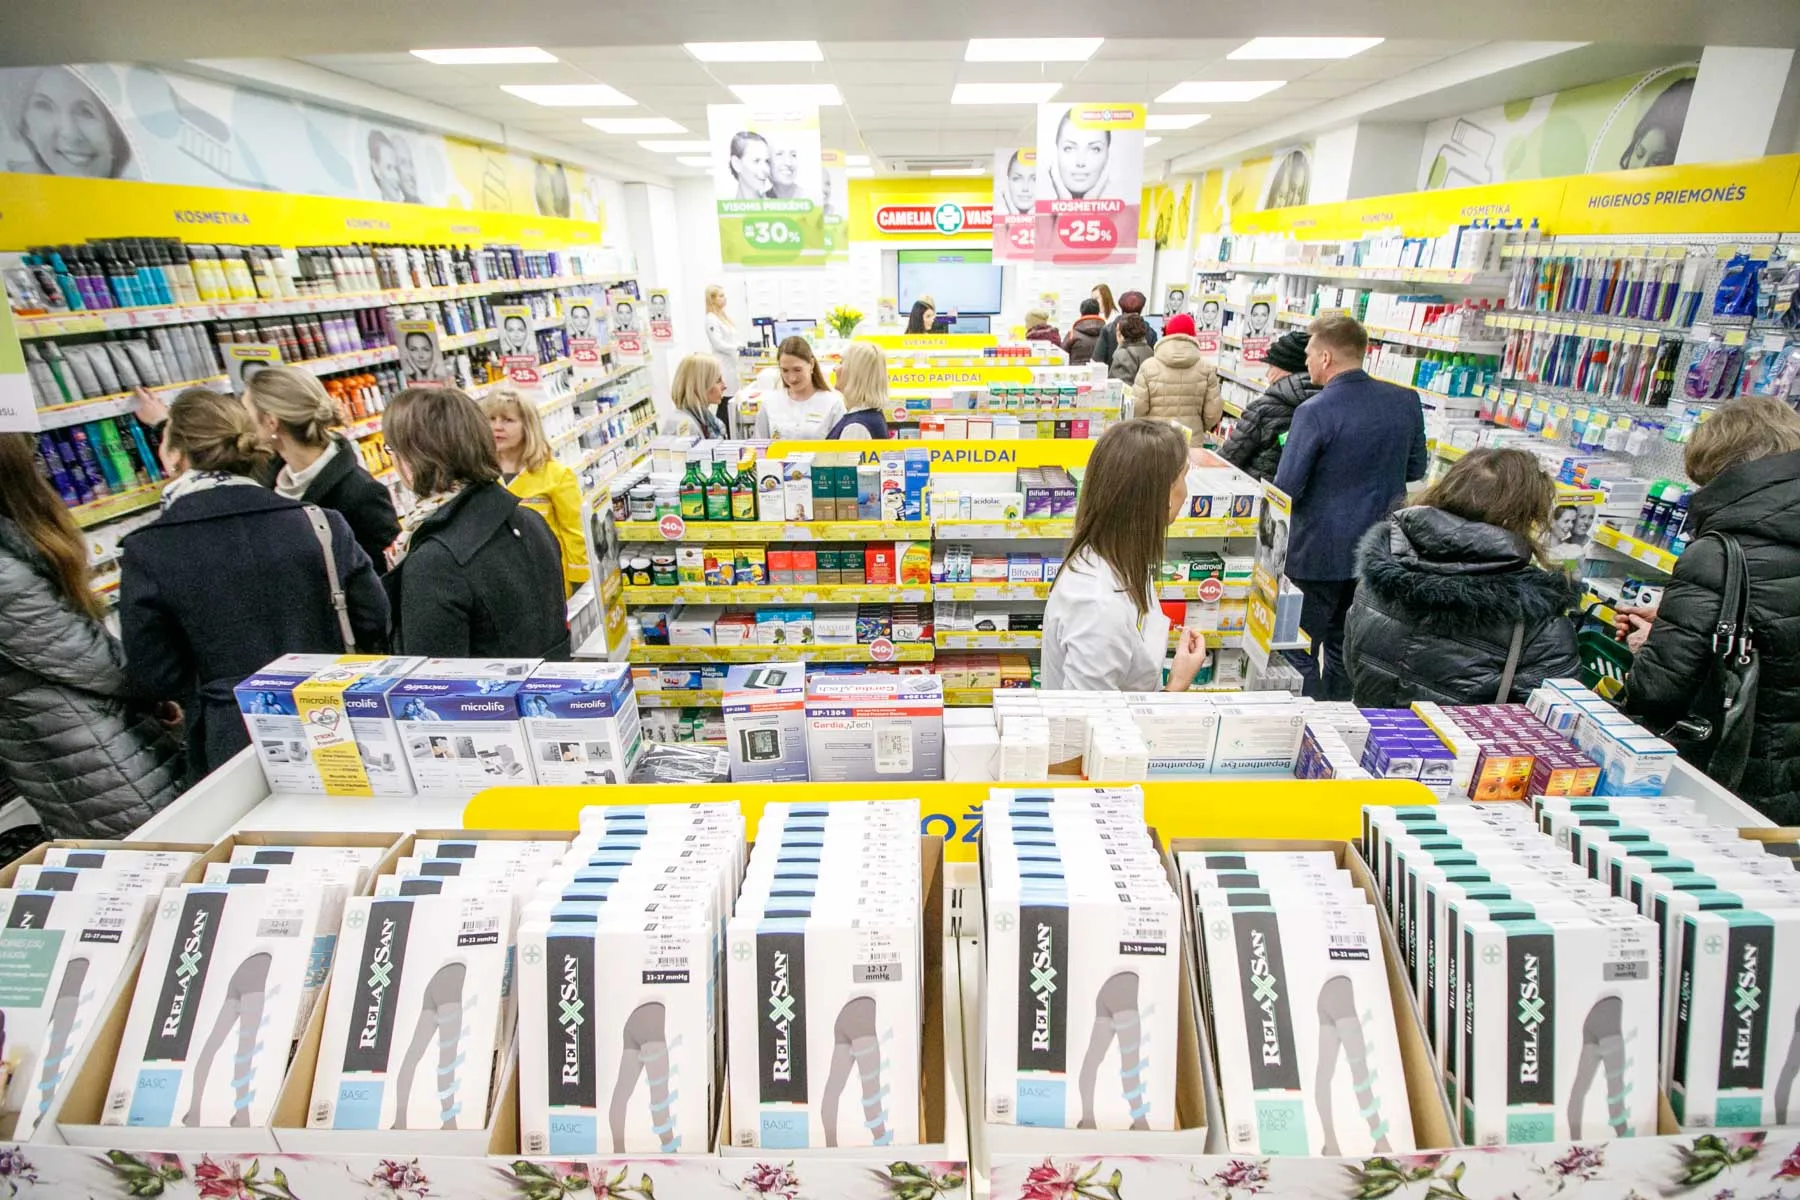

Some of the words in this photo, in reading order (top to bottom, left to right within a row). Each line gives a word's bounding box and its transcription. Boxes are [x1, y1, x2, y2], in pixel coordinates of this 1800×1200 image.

[1588, 192, 1651, 208] HIGIENOS
[1654, 183, 1748, 205] PRIEMONĖS
[1460, 204, 1511, 217] KOSMETIKA
[174, 210, 251, 226] KOSMETIKA
[879, 210, 933, 226] CAMELIA
[1059, 219, 1112, 242] -25%
[930, 449, 1017, 463] PAPILDAI
[1028, 489, 1050, 498] Bifidin
[1054, 489, 1076, 498] Bifidin
[1011, 567, 1041, 577] Bifoval
[1192, 562, 1224, 572] Gastroval
[298, 694, 341, 706] microlife
[346, 697, 379, 709] icrolife
[569, 699, 607, 710] microlife
[460, 700, 506, 713] microlife
[867, 965, 888, 974] 12-17
[665, 973, 689, 982] mmHg
[865, 972, 890, 982] mmHg
[138, 1077, 168, 1090] BASIC
[340, 1089, 370, 1101] BASIC
[1019, 1086, 1052, 1099] BASIC
[1259, 1108, 1294, 1120] MICRO
[551, 1122, 582, 1135] BASIC
[762, 1119, 794, 1131] BASIC
[1259, 1119, 1288, 1132] FIBER
